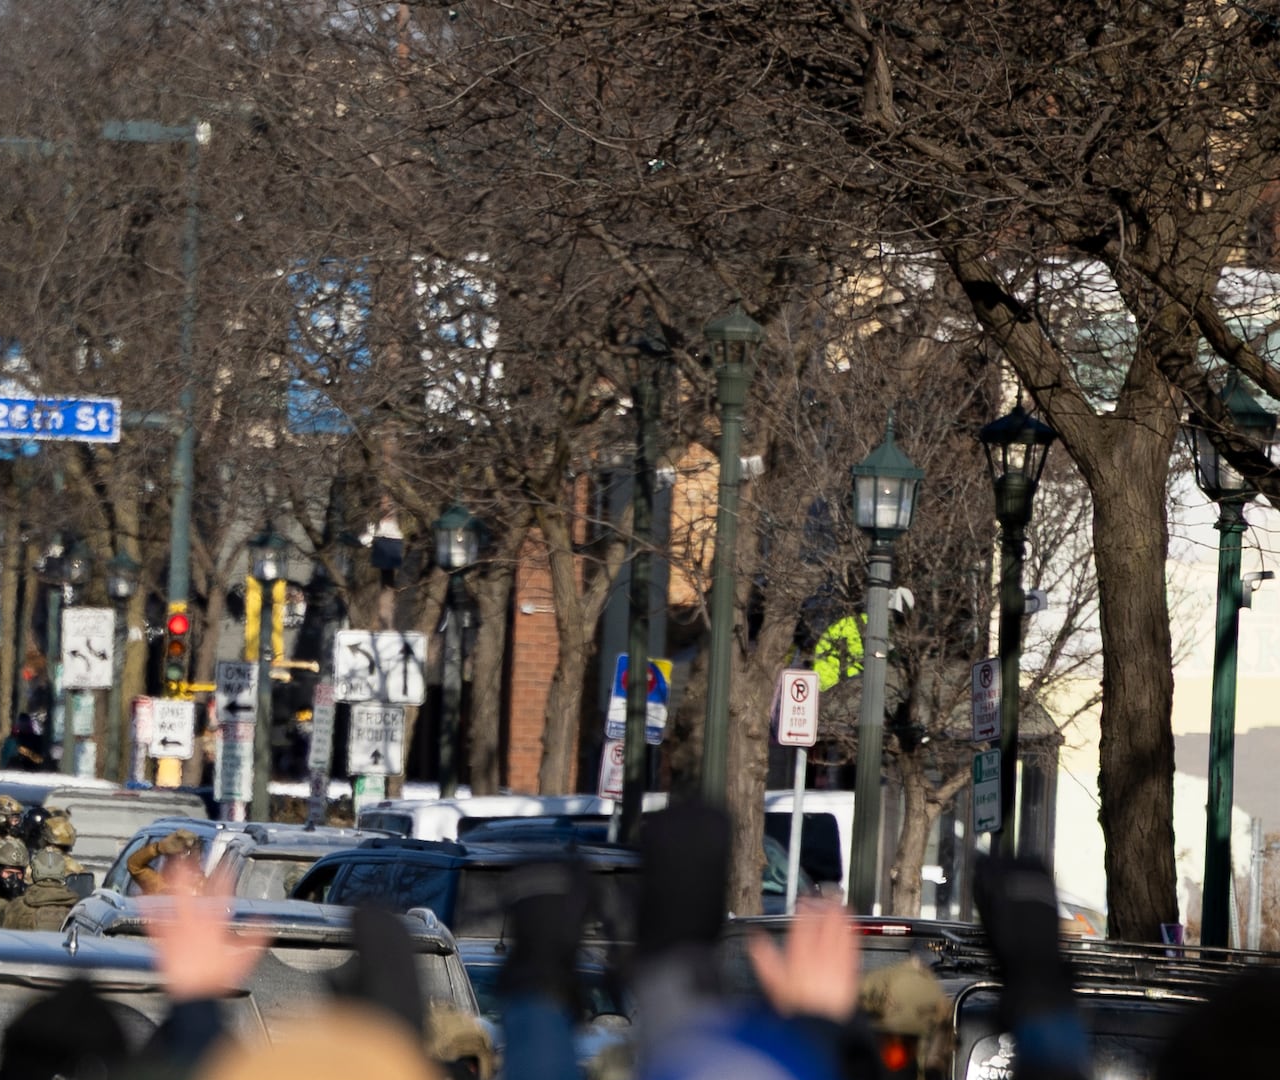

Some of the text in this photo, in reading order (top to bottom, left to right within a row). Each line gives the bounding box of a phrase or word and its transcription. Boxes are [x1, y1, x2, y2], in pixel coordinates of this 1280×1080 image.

[75, 405, 112, 433] St
[225, 666, 252, 680] ONE
[224, 681, 254, 695] WAY
[357, 709, 399, 727] TRUCK
[790, 717, 807, 728] STOP
[355, 727, 398, 743] ROUTE
